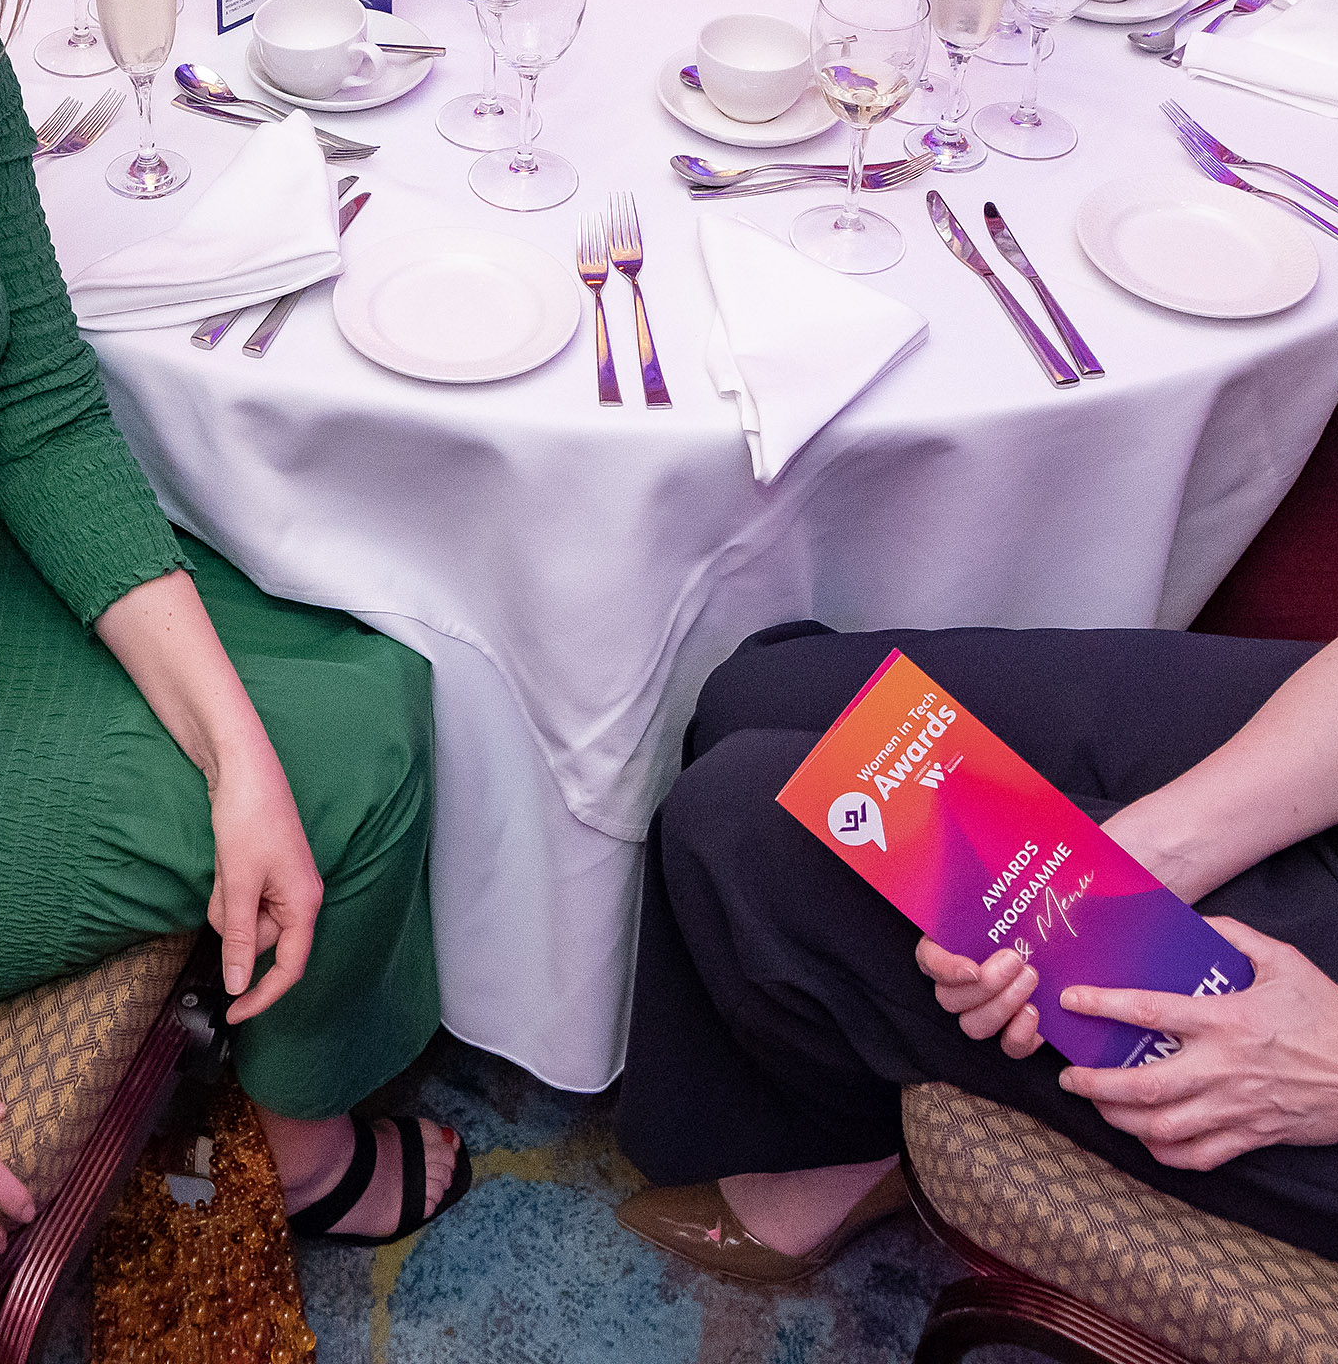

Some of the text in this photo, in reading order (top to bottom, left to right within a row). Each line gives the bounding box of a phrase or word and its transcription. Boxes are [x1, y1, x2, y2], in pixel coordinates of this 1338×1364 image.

[856, 692, 938, 782] Women in Tech
[873, 704, 957, 802] Awards
[982, 840, 1039, 912] AWARDS
[987, 841, 1073, 944] PROGRAMME
[1014, 869, 1094, 963] & Menu
[1118, 1040, 1144, 1069] ponsored
